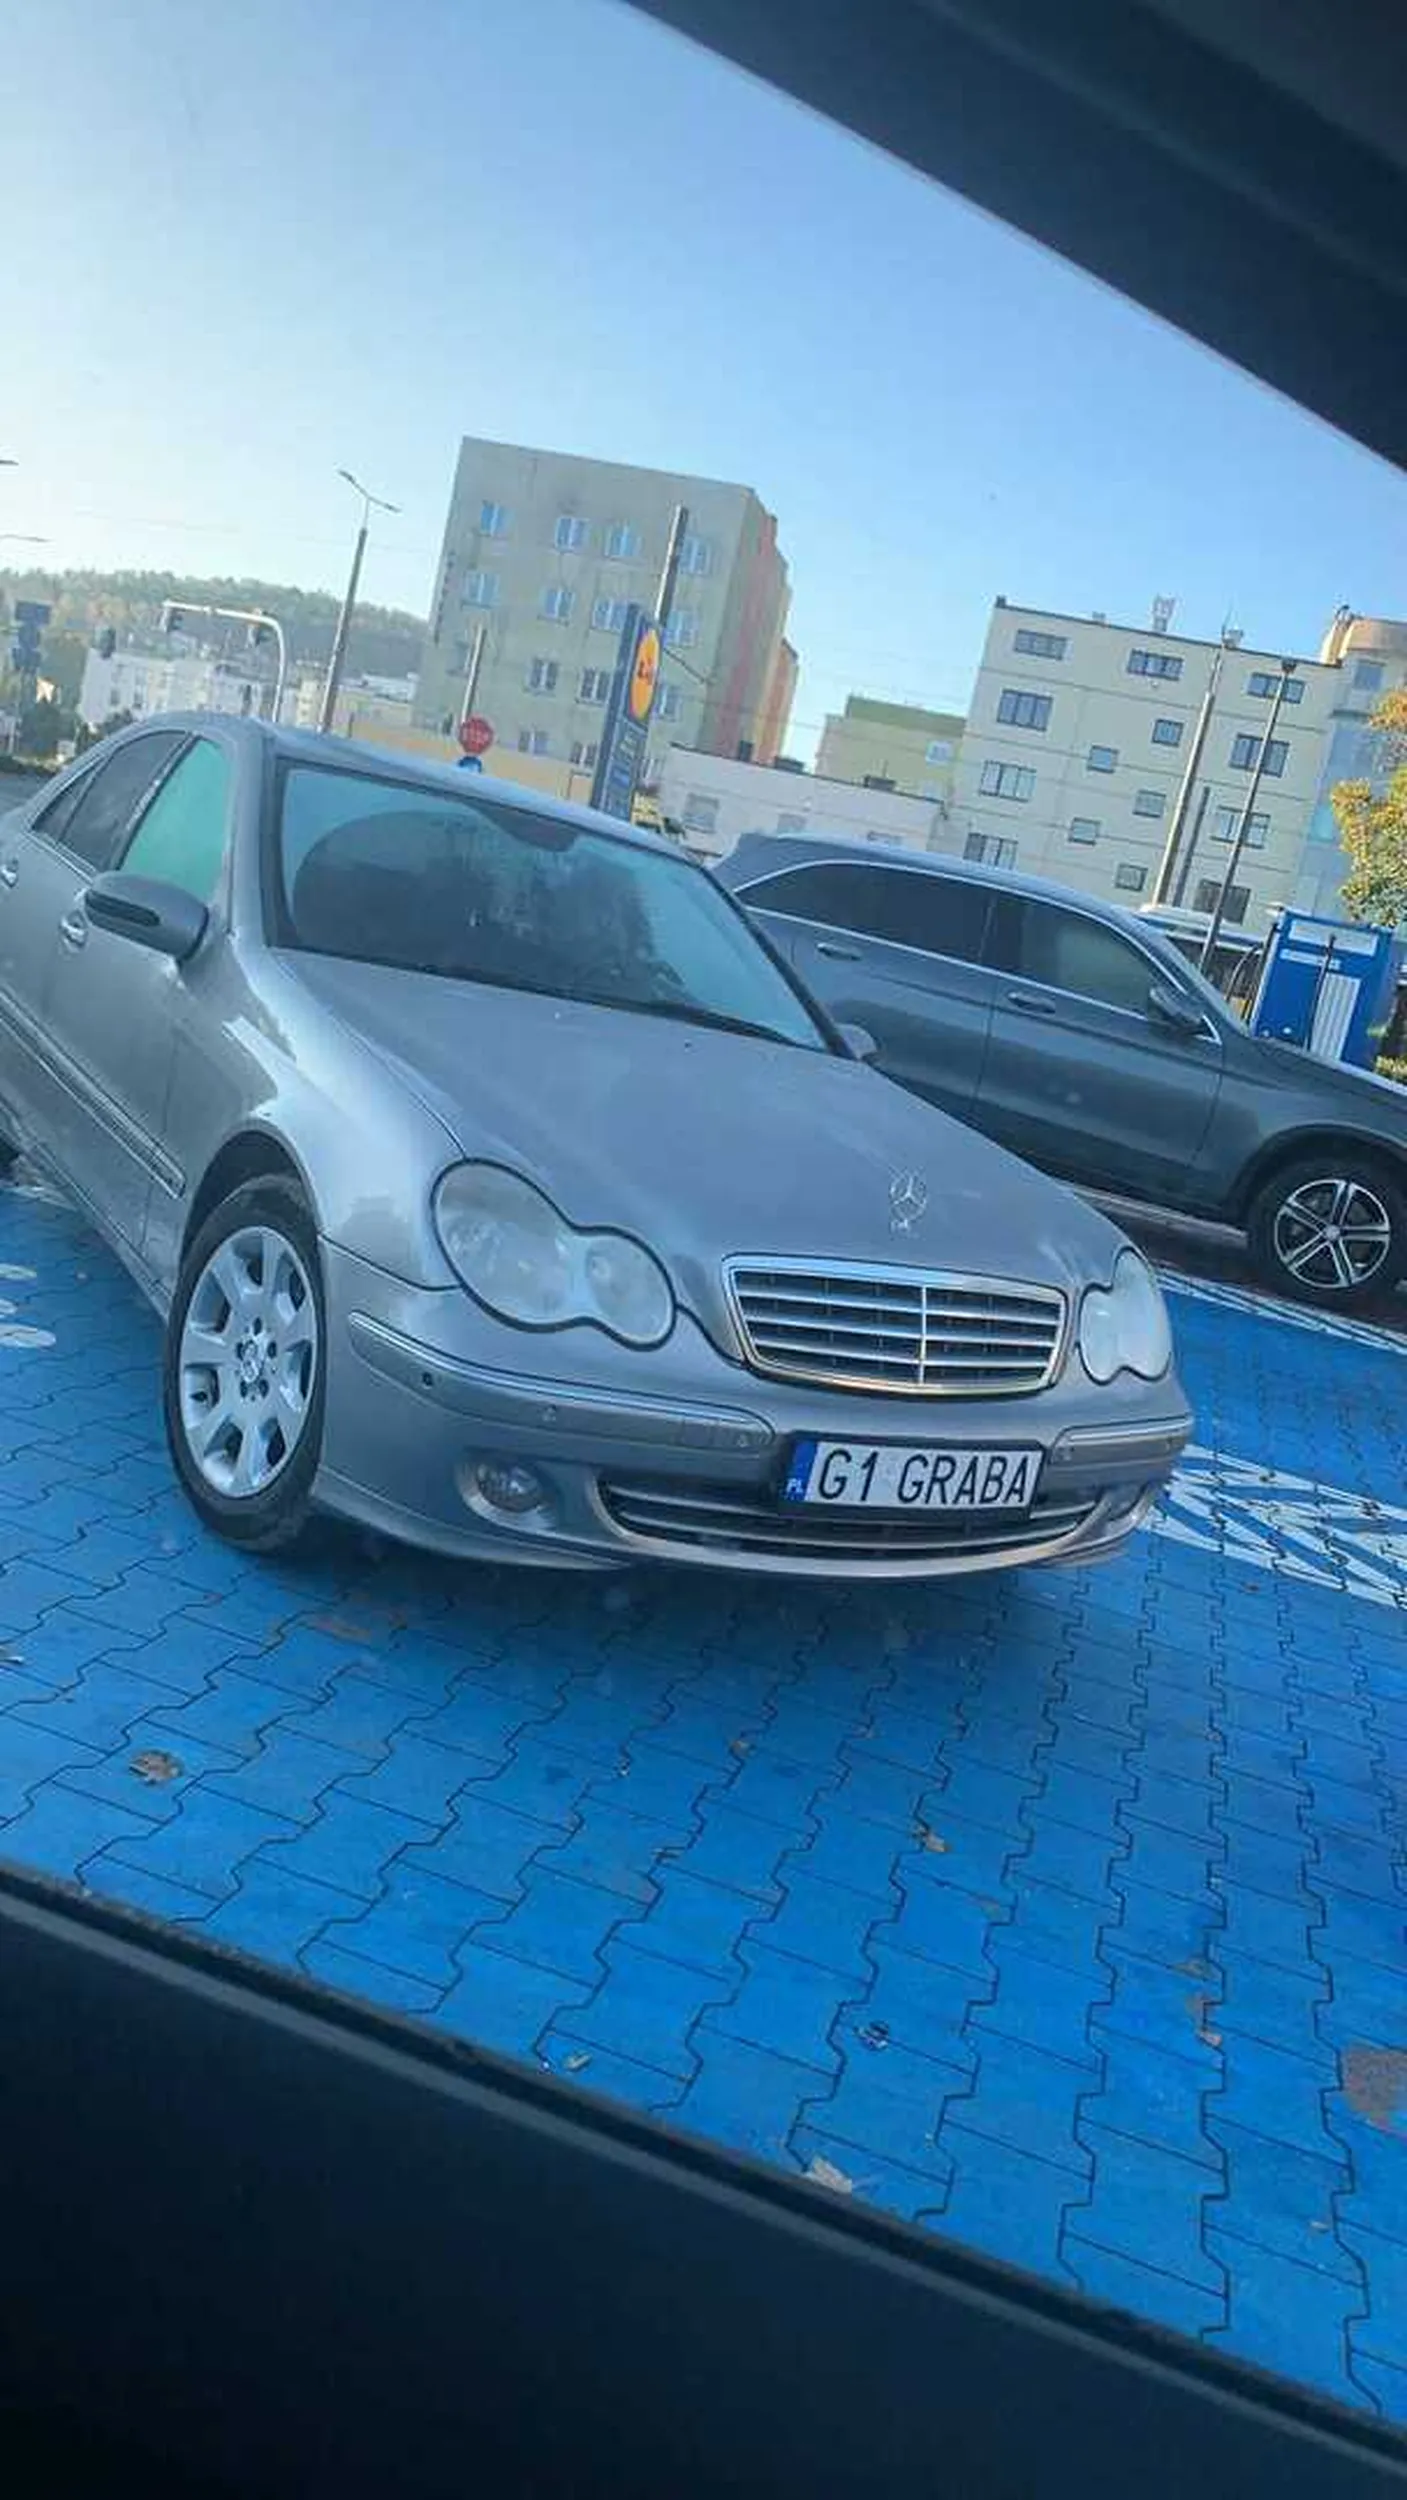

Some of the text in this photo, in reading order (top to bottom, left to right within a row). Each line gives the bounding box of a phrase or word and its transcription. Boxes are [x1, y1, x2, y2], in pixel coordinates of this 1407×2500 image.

[786, 1478, 803, 1493] PL
[818, 1449, 1029, 1505] G1 GRABA
